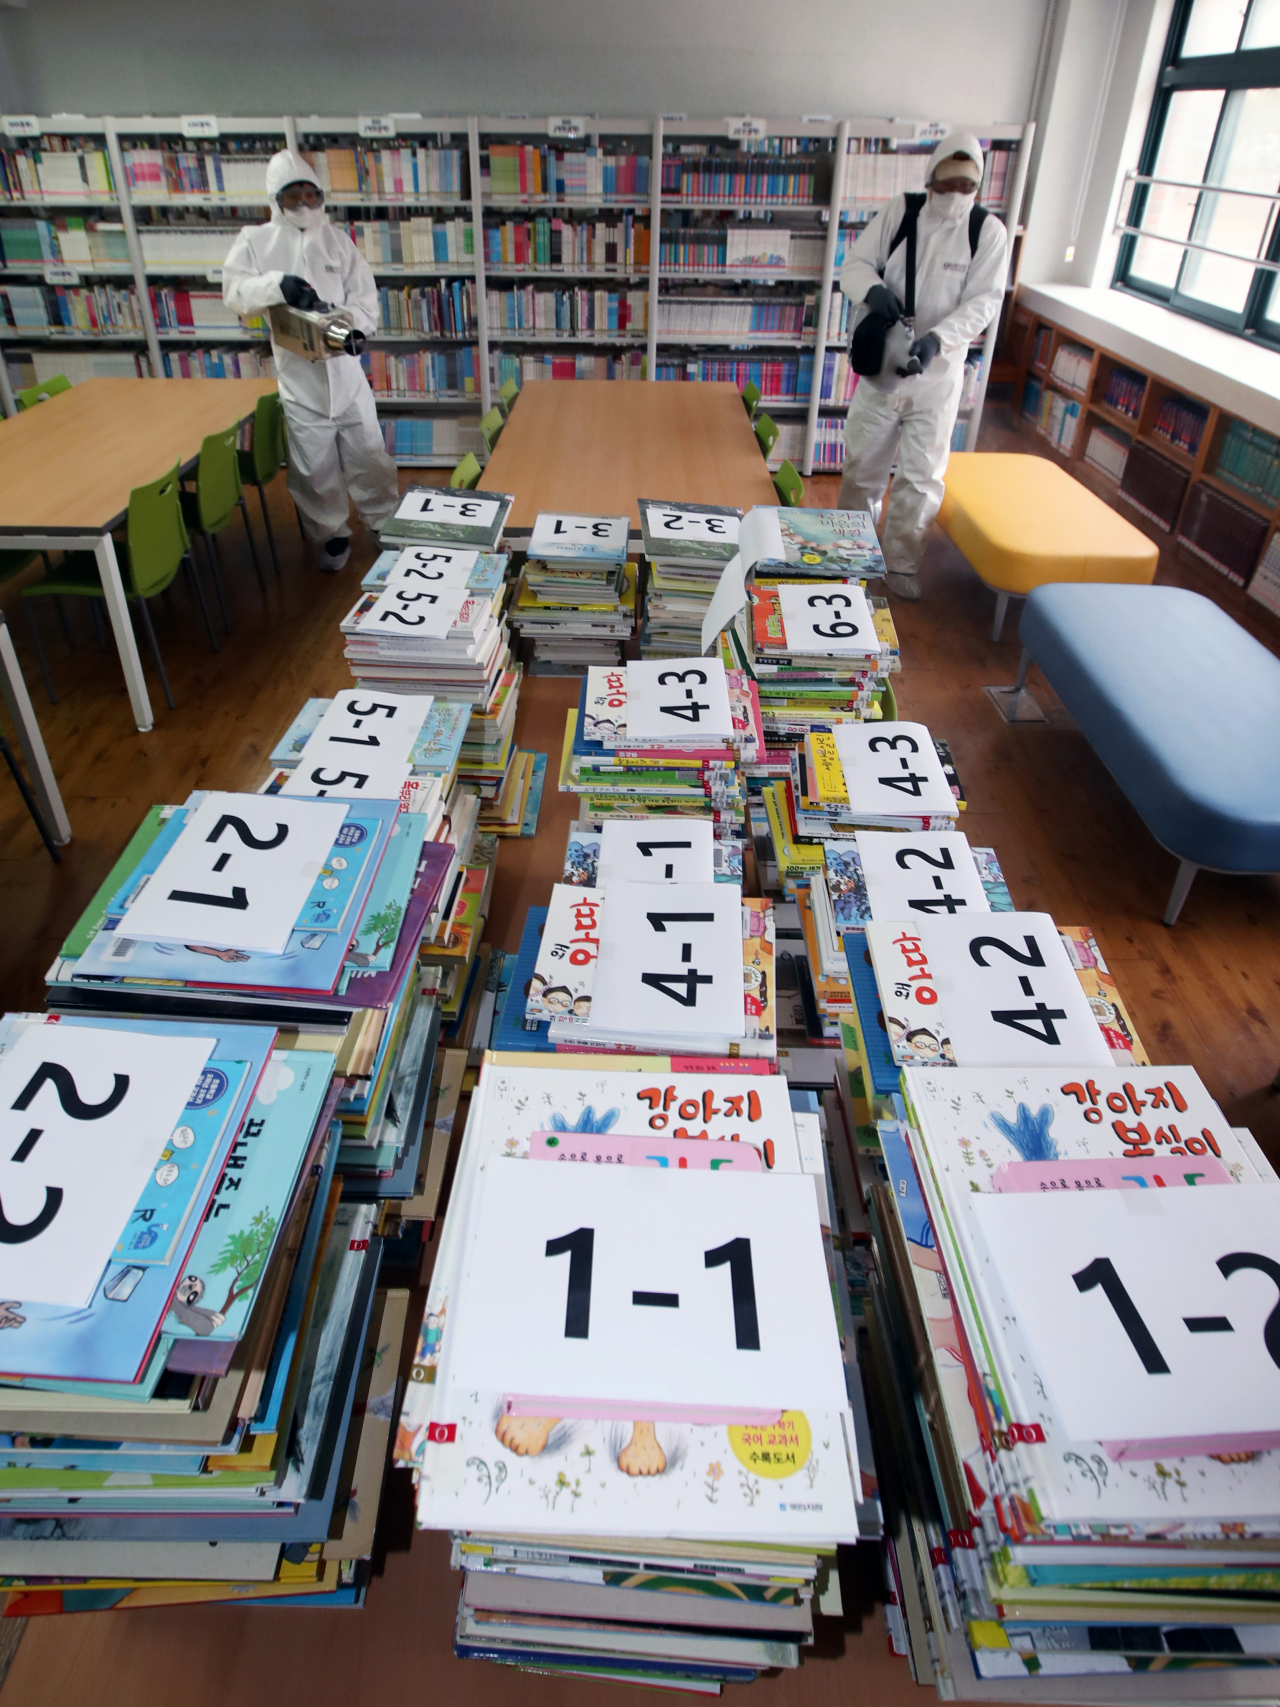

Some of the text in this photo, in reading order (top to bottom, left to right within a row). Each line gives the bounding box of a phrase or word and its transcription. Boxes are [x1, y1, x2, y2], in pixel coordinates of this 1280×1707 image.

[419, 498, 482, 518] 3-1
[553, 519, 613, 538] 3-1
[662, 513, 726, 534] 3-2
[403, 552, 453, 580] 5-2
[379, 590, 439, 626] 5-2
[807, 593, 859, 639] 6-3
[657, 669, 710, 723] 4-3
[328, 700, 398, 747] 5-1
[310, 767, 370, 797] 5-
[868, 734, 929, 797] 4-3
[167, 814, 289, 911] 2-1
[636, 841, 692, 884] -1
[550, 943, 570, 960] 왜
[641, 912, 715, 1007] 4-1
[894, 982, 912, 1000] 왜
[968, 935, 1068, 1046] 4-2
[637, 1085, 763, 1130] 강아지
[1061, 1079, 1188, 1124] 강아지
[1111, 1119, 1222, 1158] 보식이
[544, 1227, 761, 1351] 1-1
[742, 1433, 799, 1447] 국어 교과서
[749, 1451, 796, 1465] 수록도서
